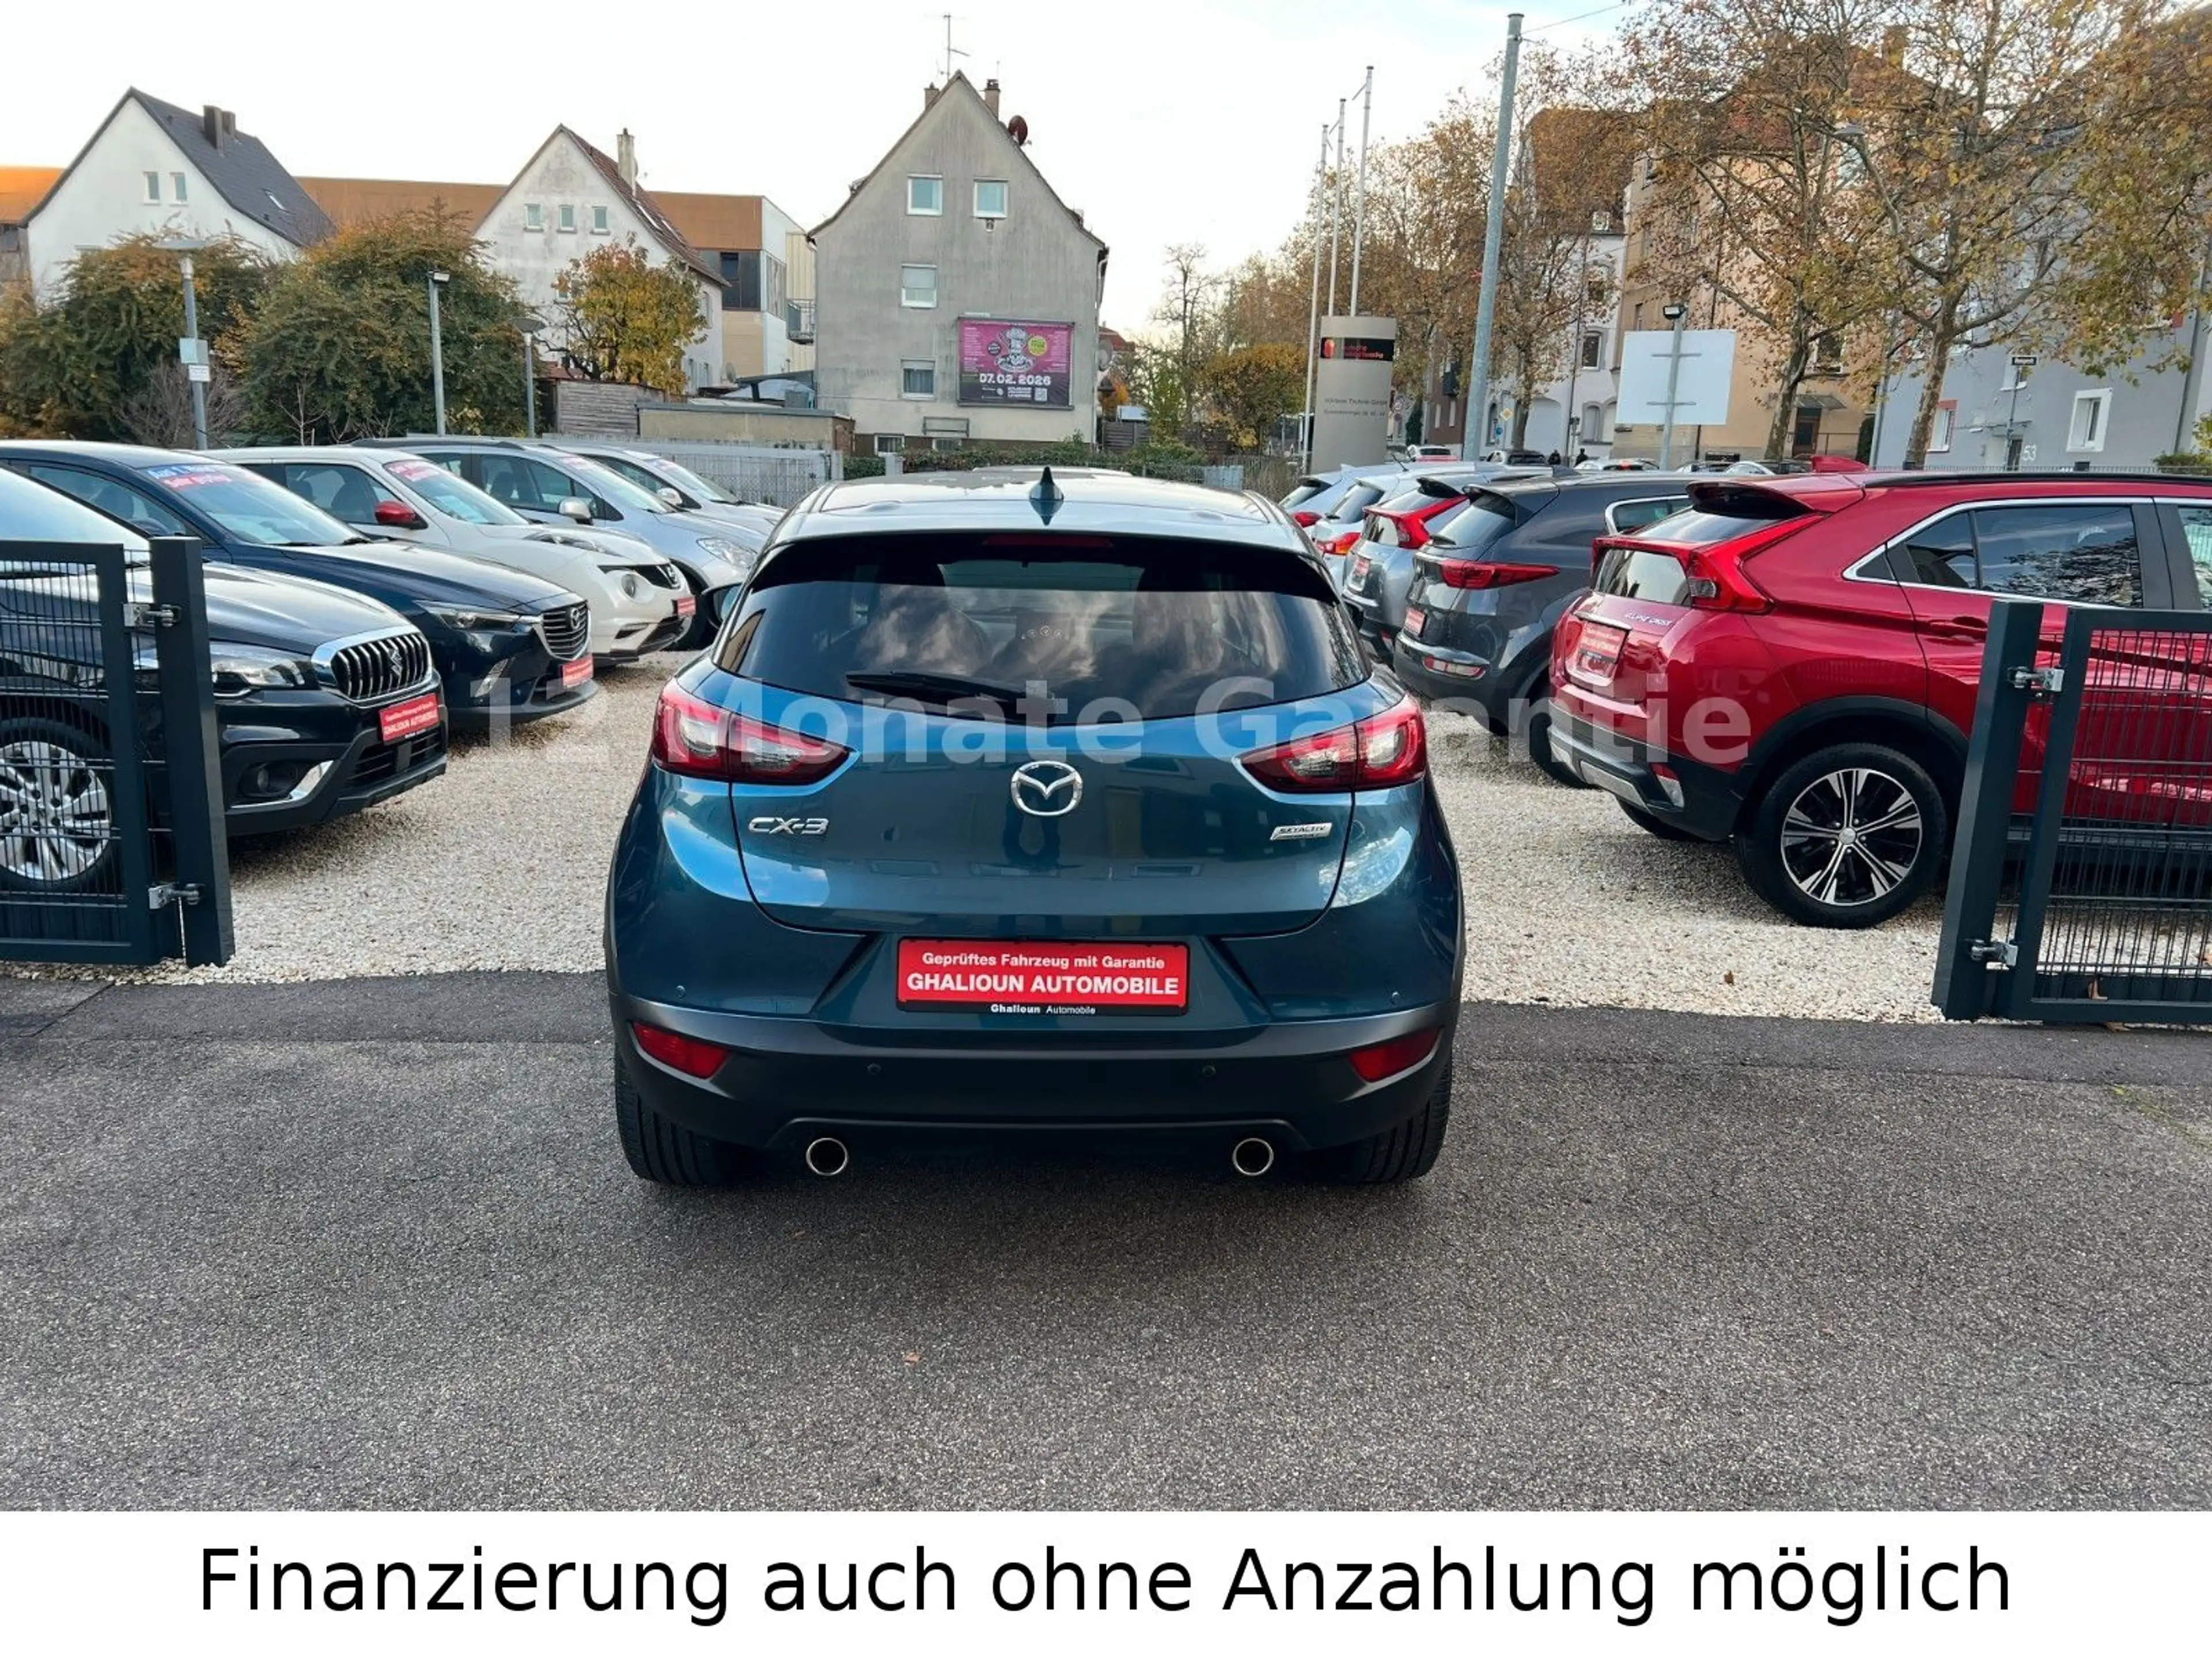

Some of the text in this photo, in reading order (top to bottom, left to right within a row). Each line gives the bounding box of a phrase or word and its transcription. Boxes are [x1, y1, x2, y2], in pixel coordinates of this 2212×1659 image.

[2022, 444, 2037, 461] 53
[748, 817, 829, 834] CX-3
[922, 952, 1165, 969] Geprüftes Fahrzeug mit Garantie
[907, 973, 1179, 995] GHALIOUN AUTOMOBILE
[991, 1003, 1096, 1015] Ghalioun Automobile
